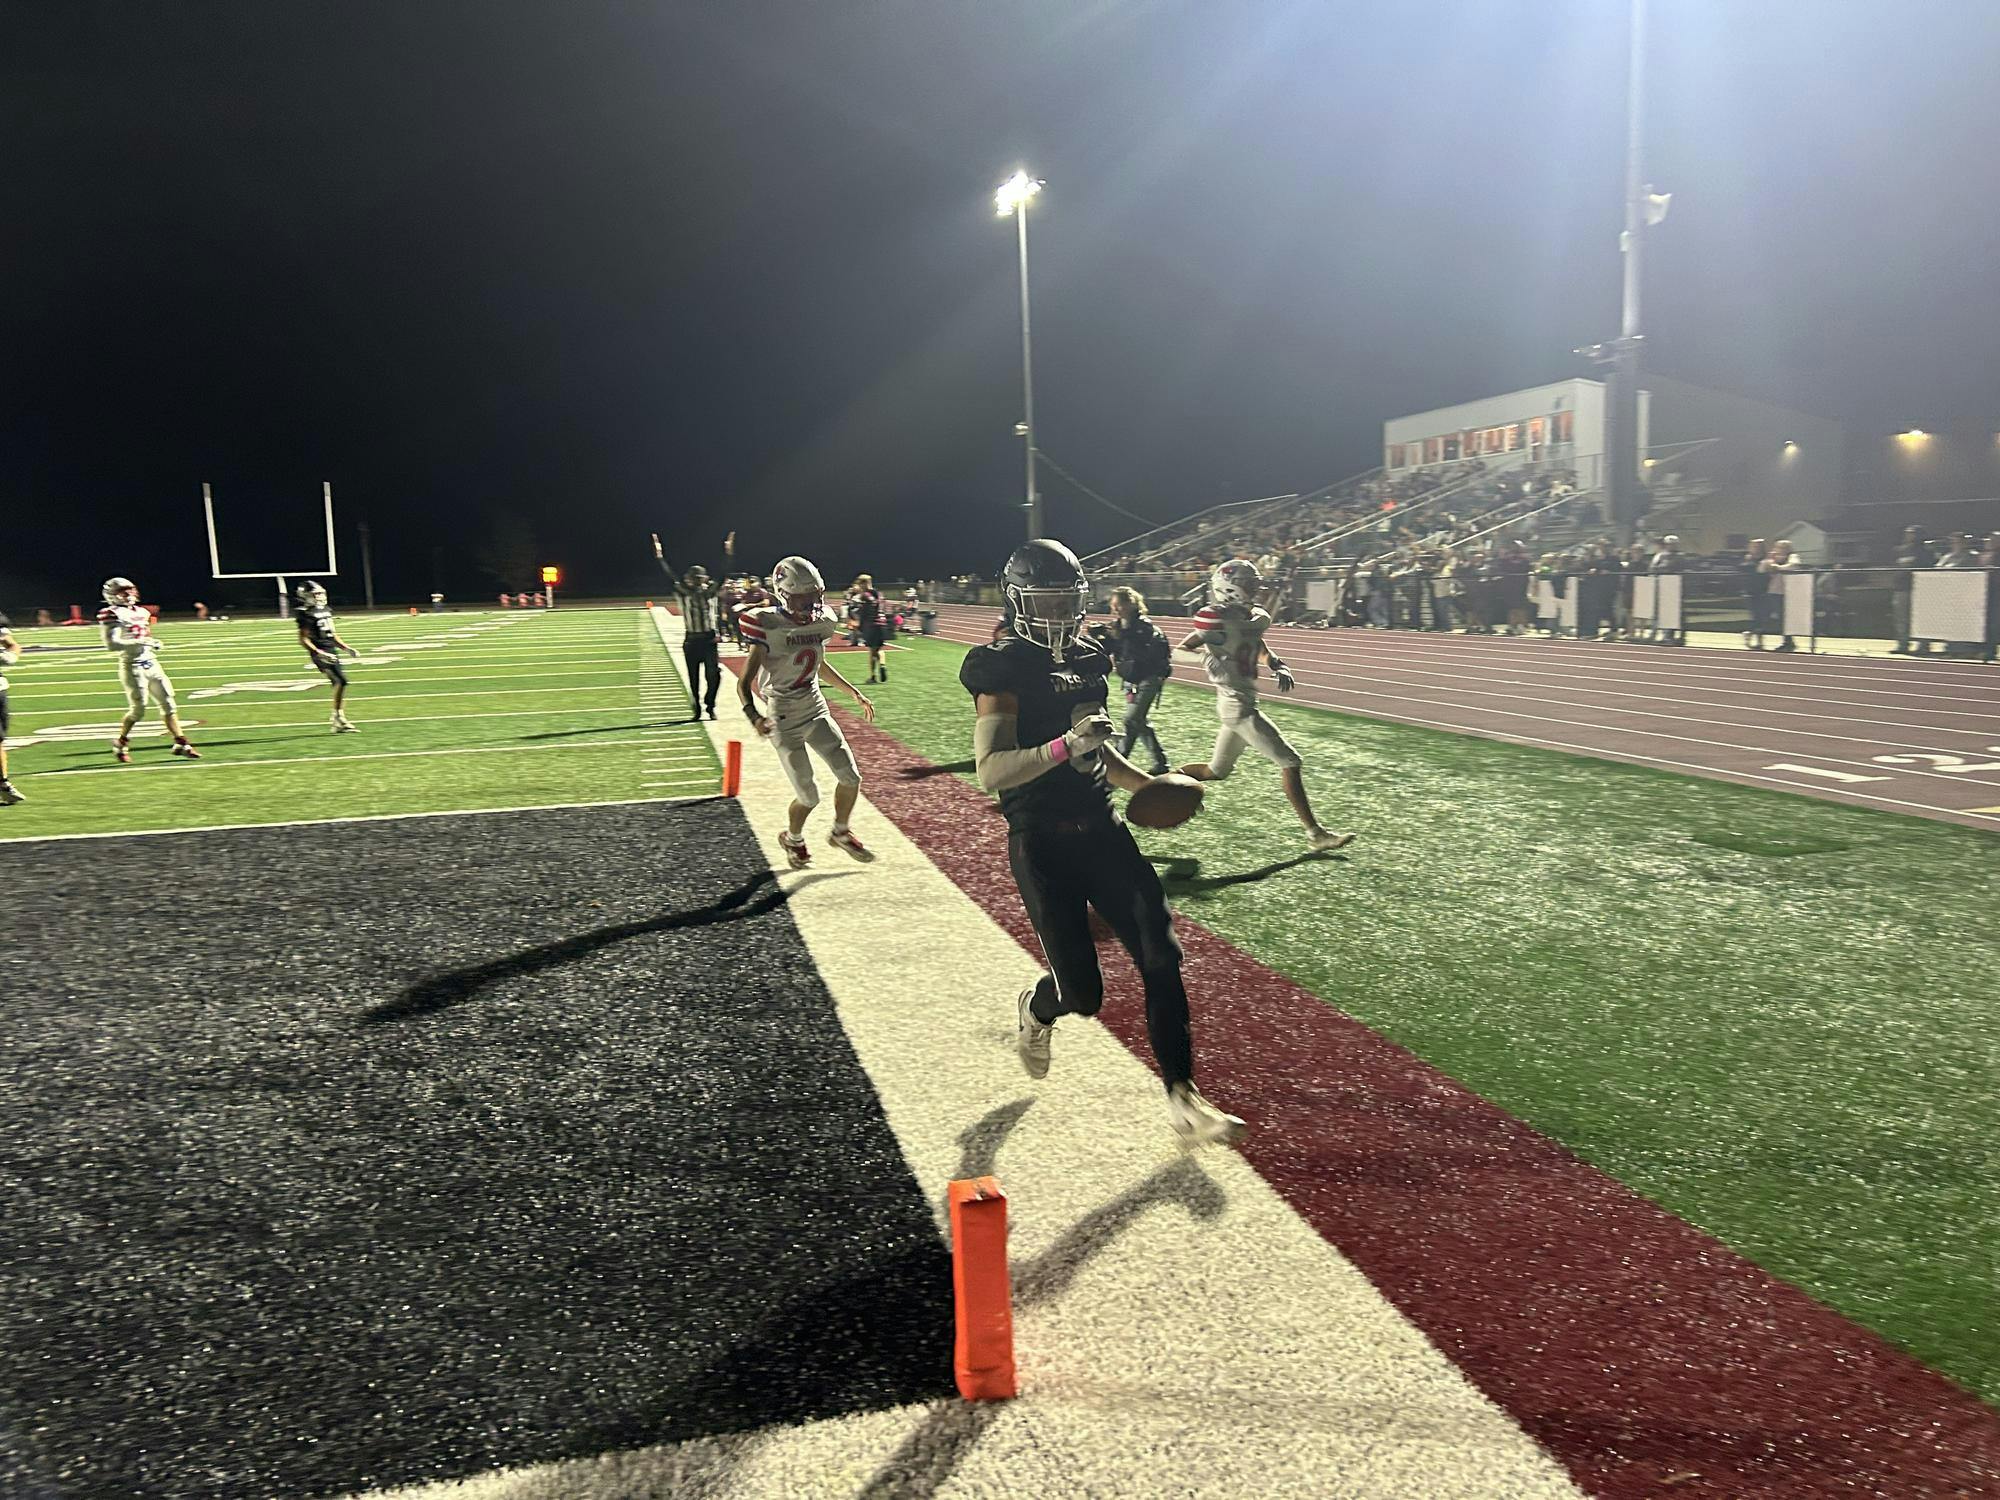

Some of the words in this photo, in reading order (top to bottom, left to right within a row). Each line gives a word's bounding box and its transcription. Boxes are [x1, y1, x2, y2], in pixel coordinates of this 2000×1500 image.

[791, 648, 818, 690] 2
[1050, 673, 1107, 693] WES-DE
[1761, 763, 1896, 783] 1
